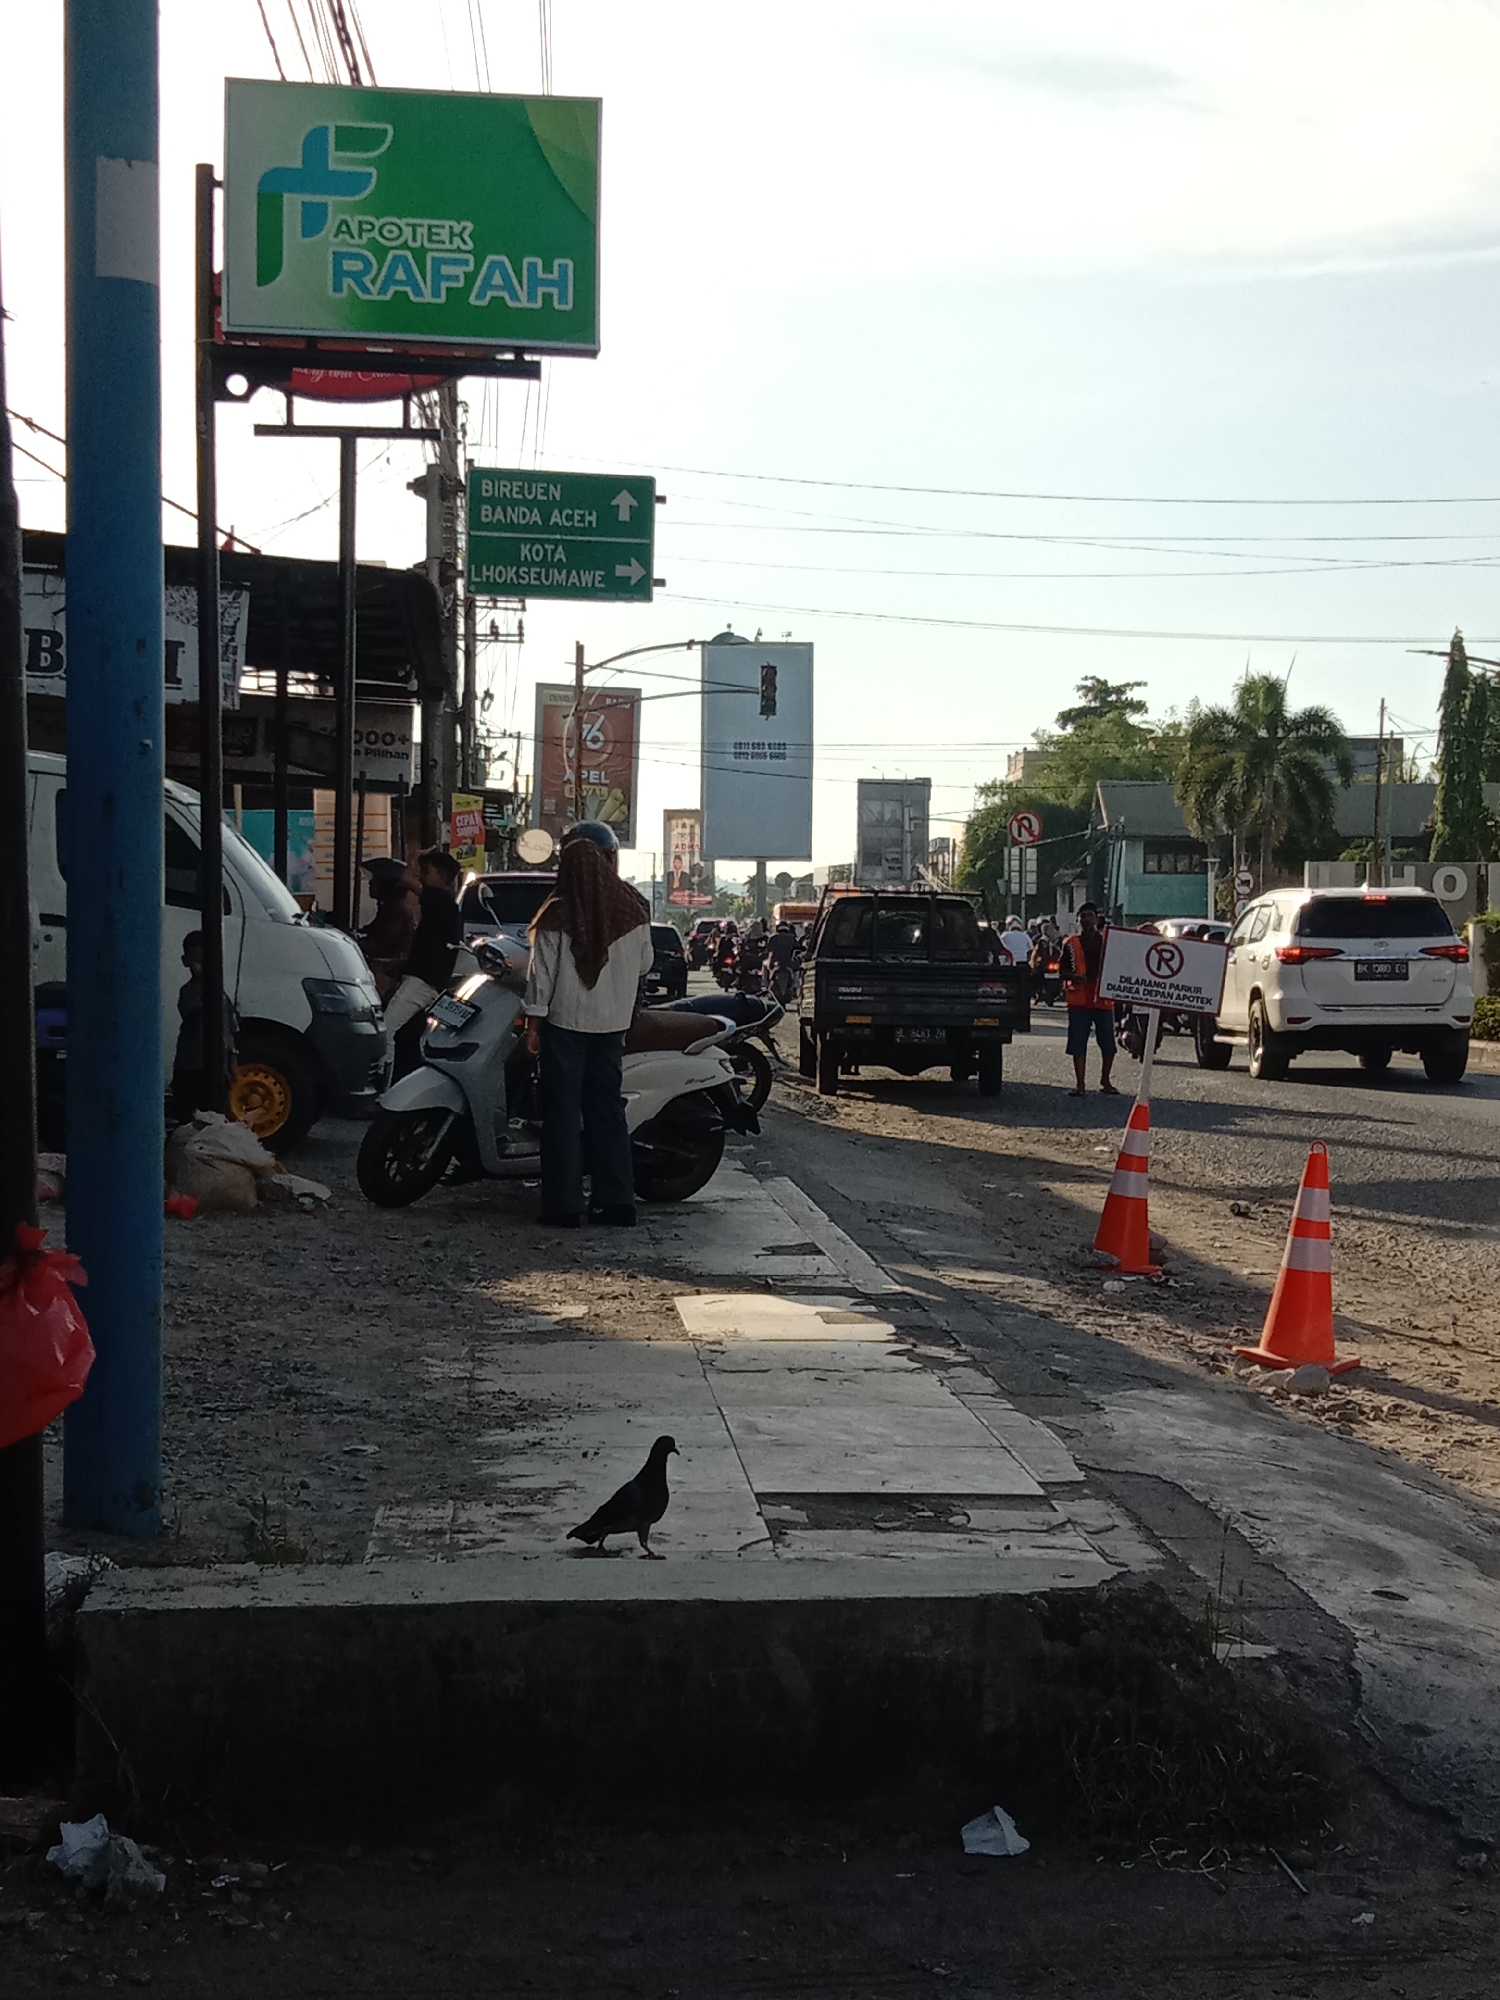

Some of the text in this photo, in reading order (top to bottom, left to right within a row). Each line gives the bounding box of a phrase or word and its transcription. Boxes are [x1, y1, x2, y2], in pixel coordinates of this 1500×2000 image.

[333, 218, 473, 249] APOTEK
[331, 249, 573, 308] RAFAH
[481, 479, 562, 501] BIREUEN
[480, 504, 597, 528] BANDA ACEH
[520, 542, 567, 563] KOTA
[470, 564, 606, 588] LHOKSEUMAWE
[1106, 983, 1213, 1006] DIAREA DEPAN APOTEK
[1119, 975, 1202, 995] DILARANG PARKIR
